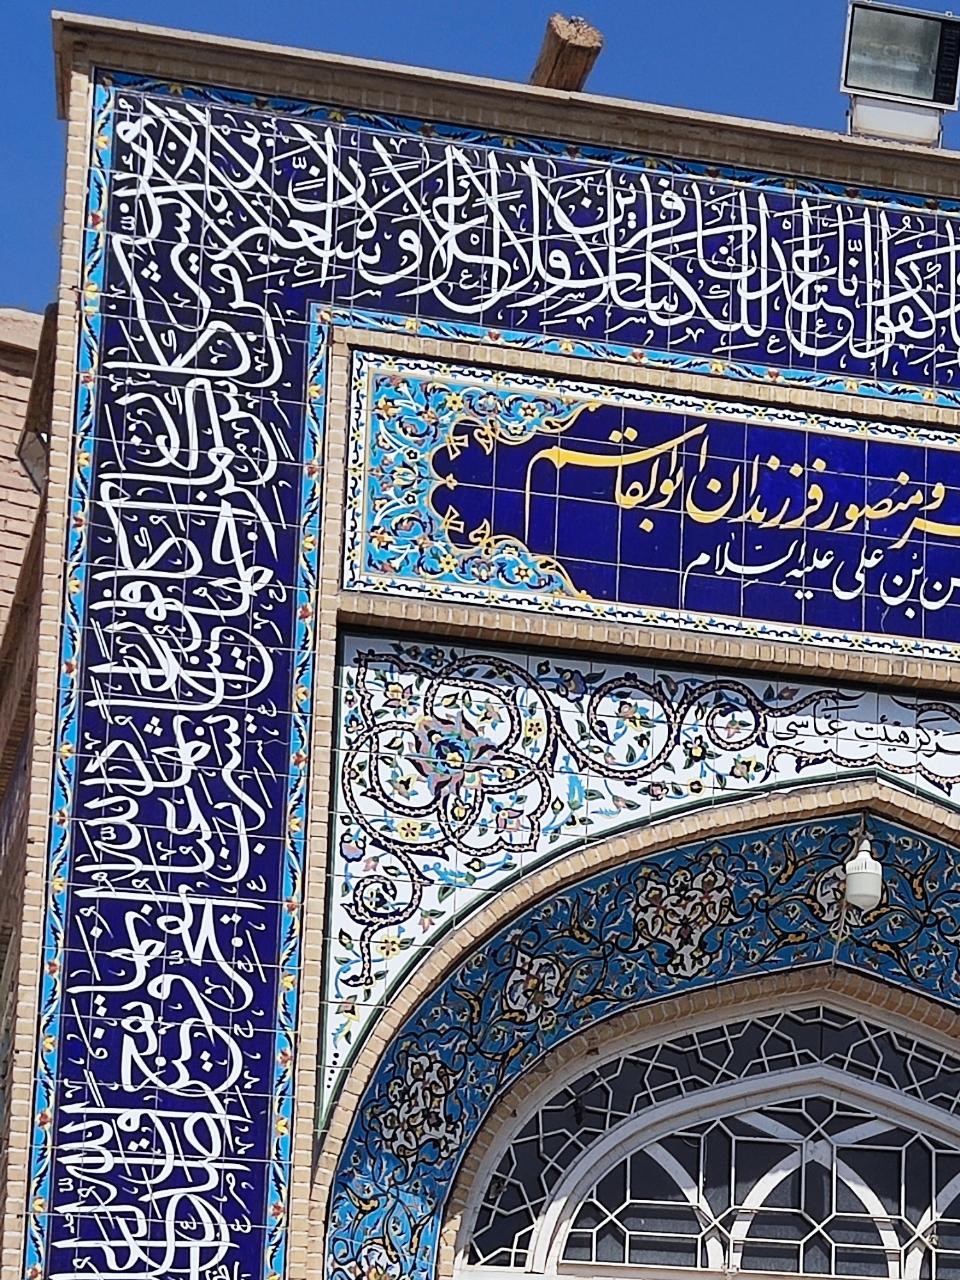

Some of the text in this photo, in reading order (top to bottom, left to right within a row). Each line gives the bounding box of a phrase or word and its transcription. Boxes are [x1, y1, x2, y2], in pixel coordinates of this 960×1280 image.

[686, 454, 827, 530] فرزندان
[681, 534, 808, 610] السلام
[782, 547, 836, 601] علیه
[832, 545, 885, 600] علی
[879, 553, 925, 620] بن
